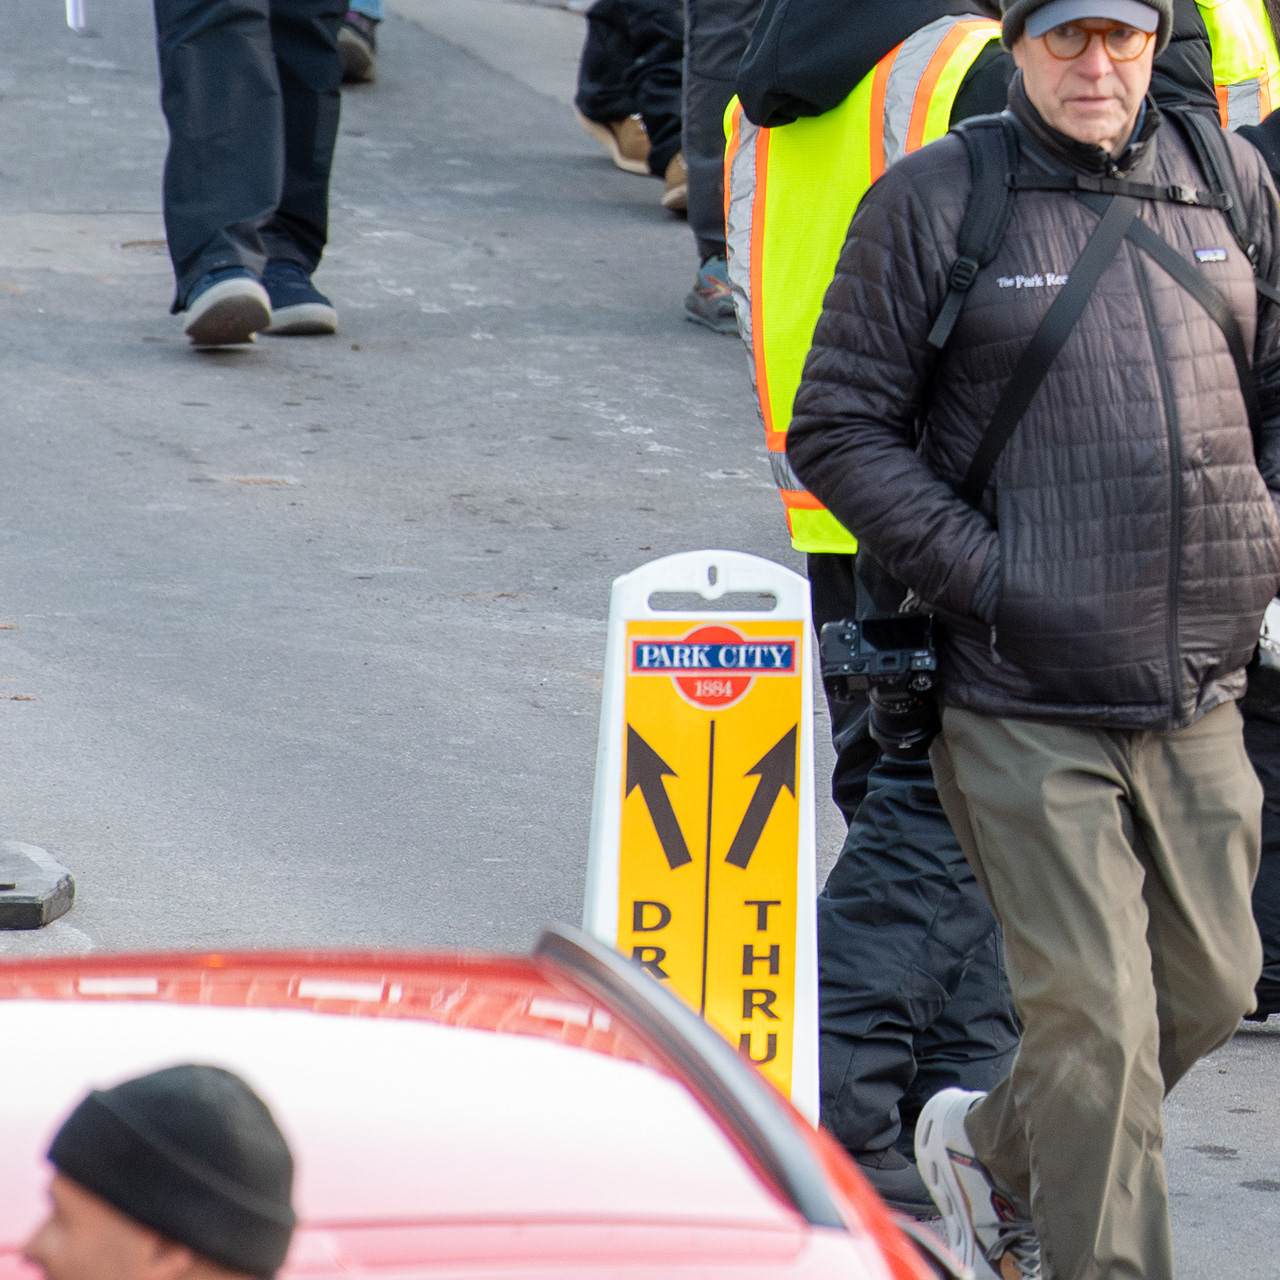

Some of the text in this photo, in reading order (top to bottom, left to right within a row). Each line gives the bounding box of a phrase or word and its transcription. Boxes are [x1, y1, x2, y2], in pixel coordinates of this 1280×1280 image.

[1015, 273, 1044, 288] Park
[641, 644, 793, 669] PARK CITY
[694, 679, 733, 699] 1884
[738, 900, 782, 1066] THRU
